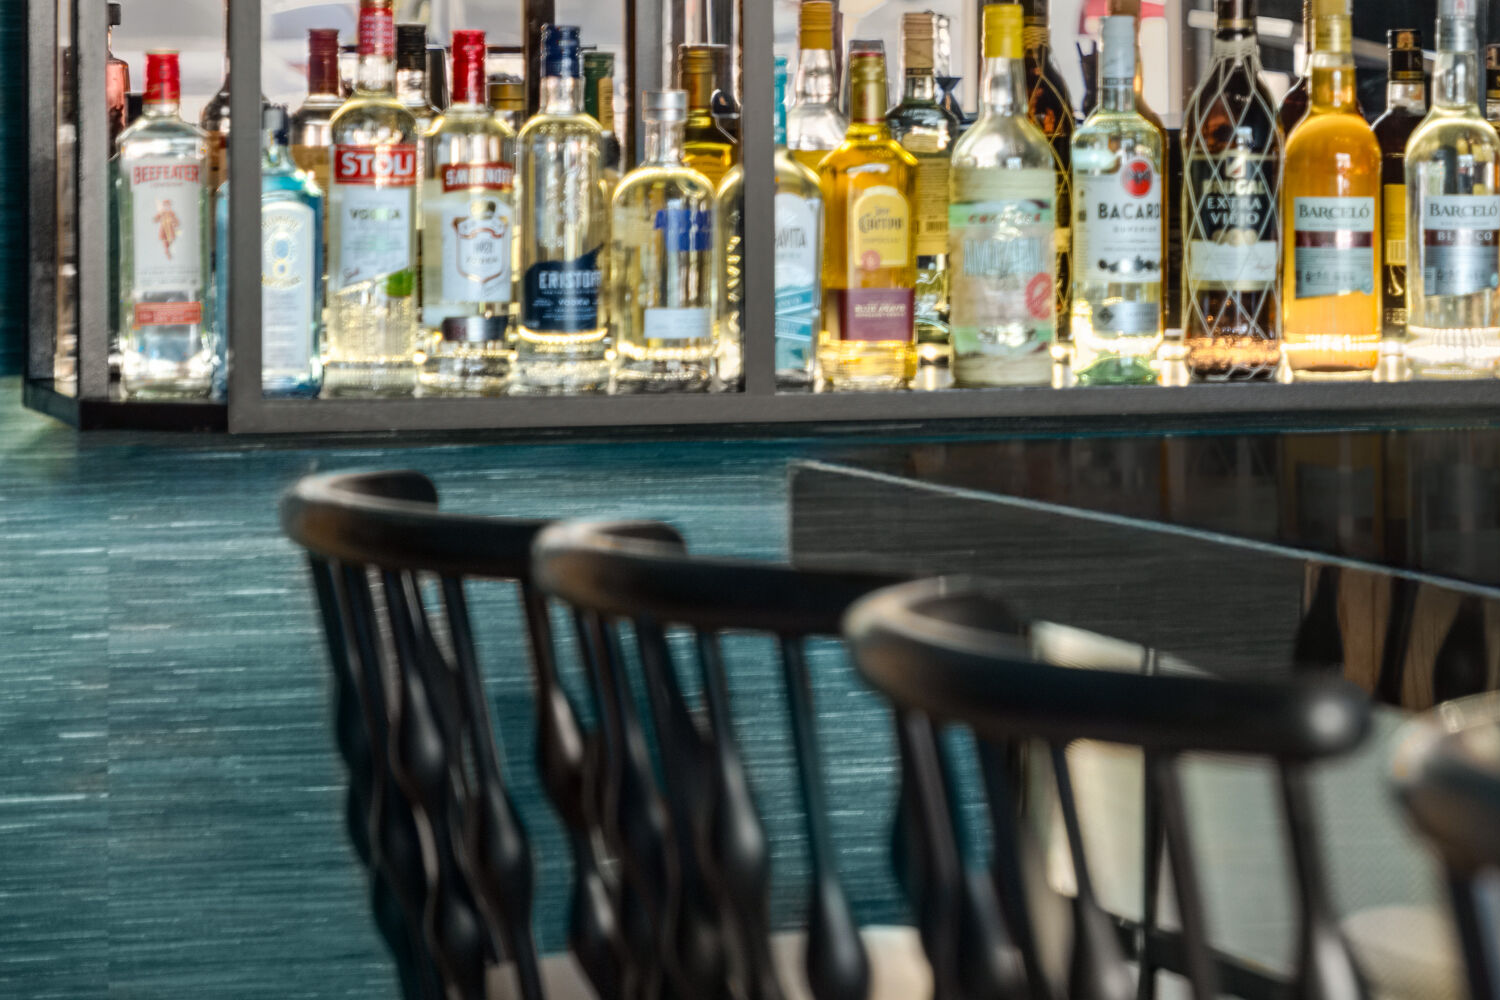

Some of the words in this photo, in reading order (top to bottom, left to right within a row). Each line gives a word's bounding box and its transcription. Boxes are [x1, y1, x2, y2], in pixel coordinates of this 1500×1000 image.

[341, 152, 414, 176] STOLI
[133, 165, 200, 184] BEEFEATER
[1207, 198, 1262, 210] EXTRA
[1299, 203, 1370, 220] BARCELÓ
[1429, 200, 1498, 218] BARCELÓ
[351, 207, 400, 219] VODA
[1437, 231, 1492, 241] BLCO
